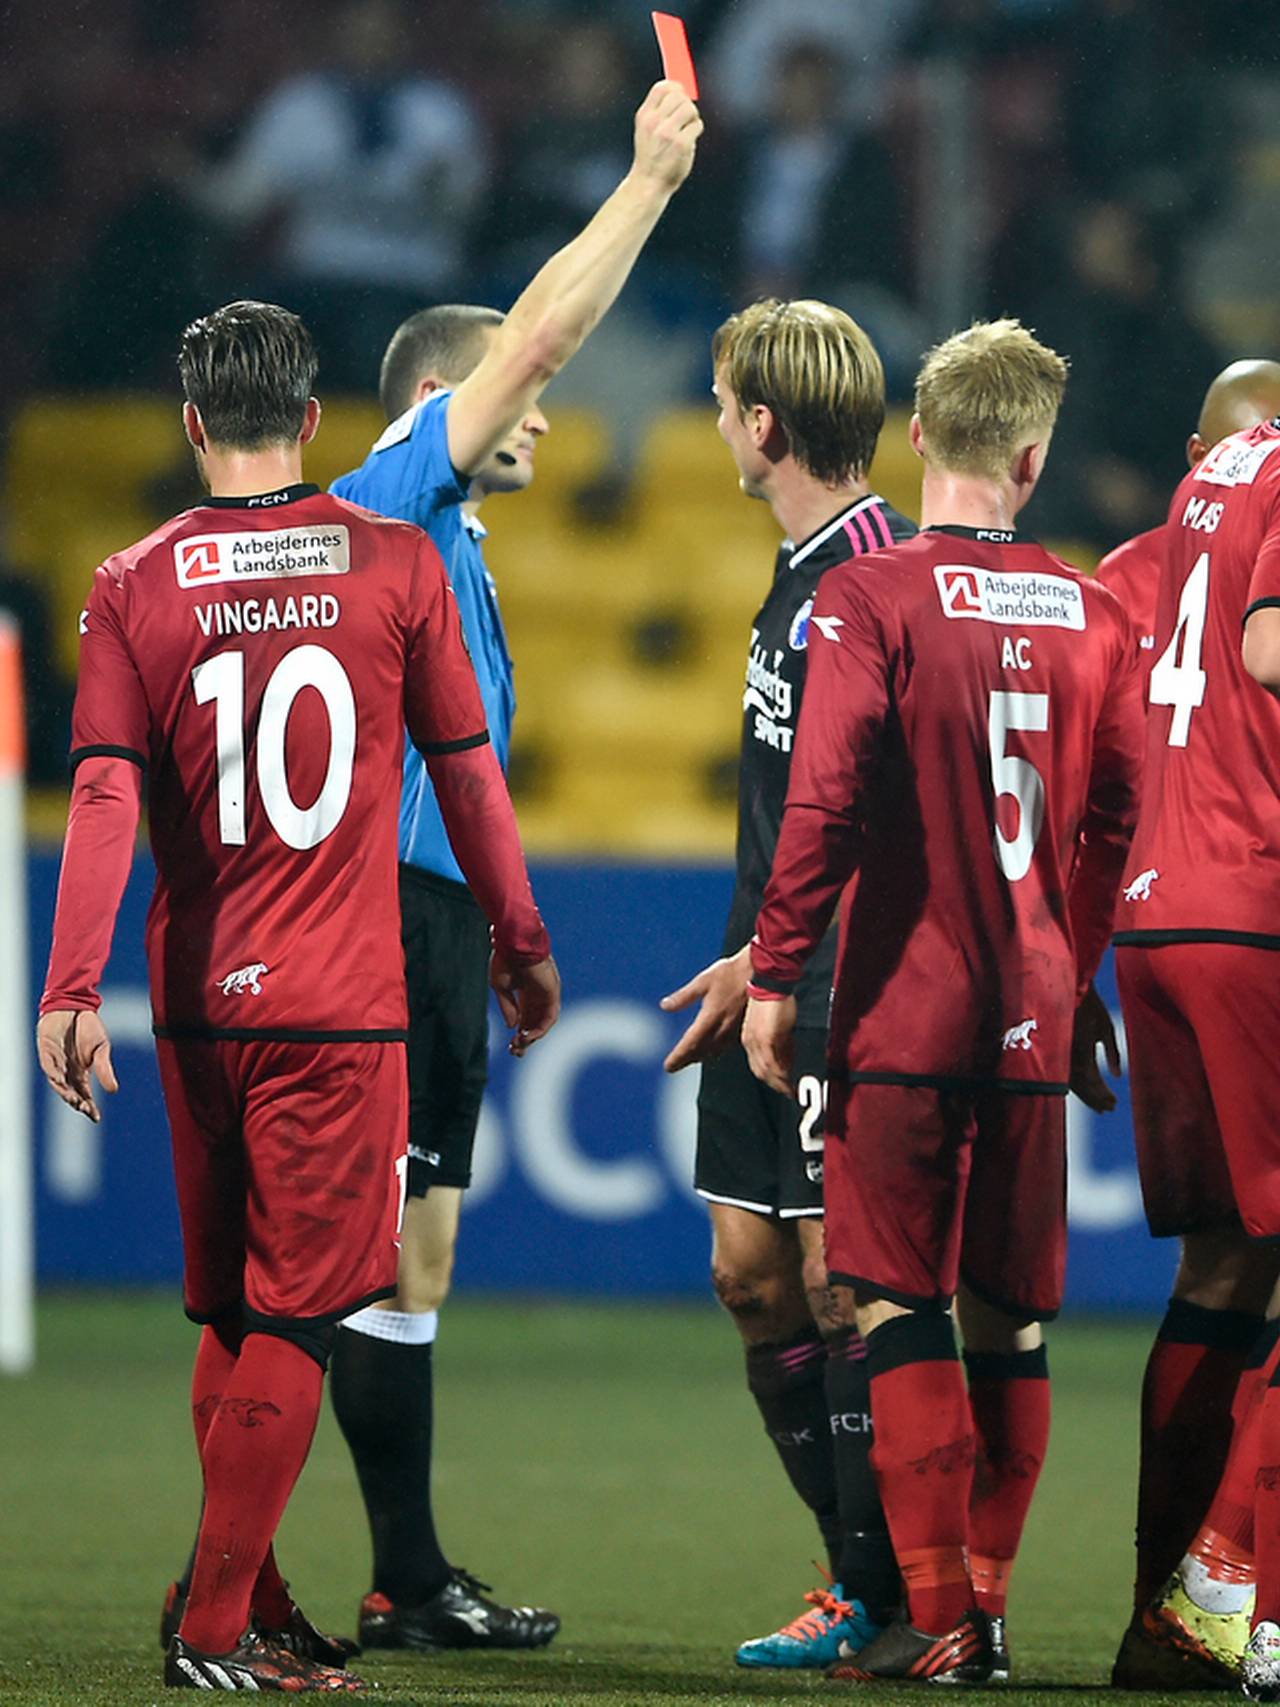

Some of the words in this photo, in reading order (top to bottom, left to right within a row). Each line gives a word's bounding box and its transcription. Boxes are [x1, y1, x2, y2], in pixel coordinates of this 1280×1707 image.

[247, 492, 289, 508] FCN
[1182, 496, 1225, 534] MAS
[231, 533, 342, 556] Arbejdernes
[976, 530, 1014, 542] FCN
[232, 552, 331, 574] Landsbank
[985, 576, 1079, 602] Arbejdernes
[194, 594, 340, 637] VINGAARD
[987, 598, 1071, 622] Landsbank
[1001, 636, 1033, 671] AC
[1149, 552, 1210, 747] 4
[192, 644, 357, 851] 10
[989, 691, 1049, 882] 5
[798, 1074, 829, 1152] 2
